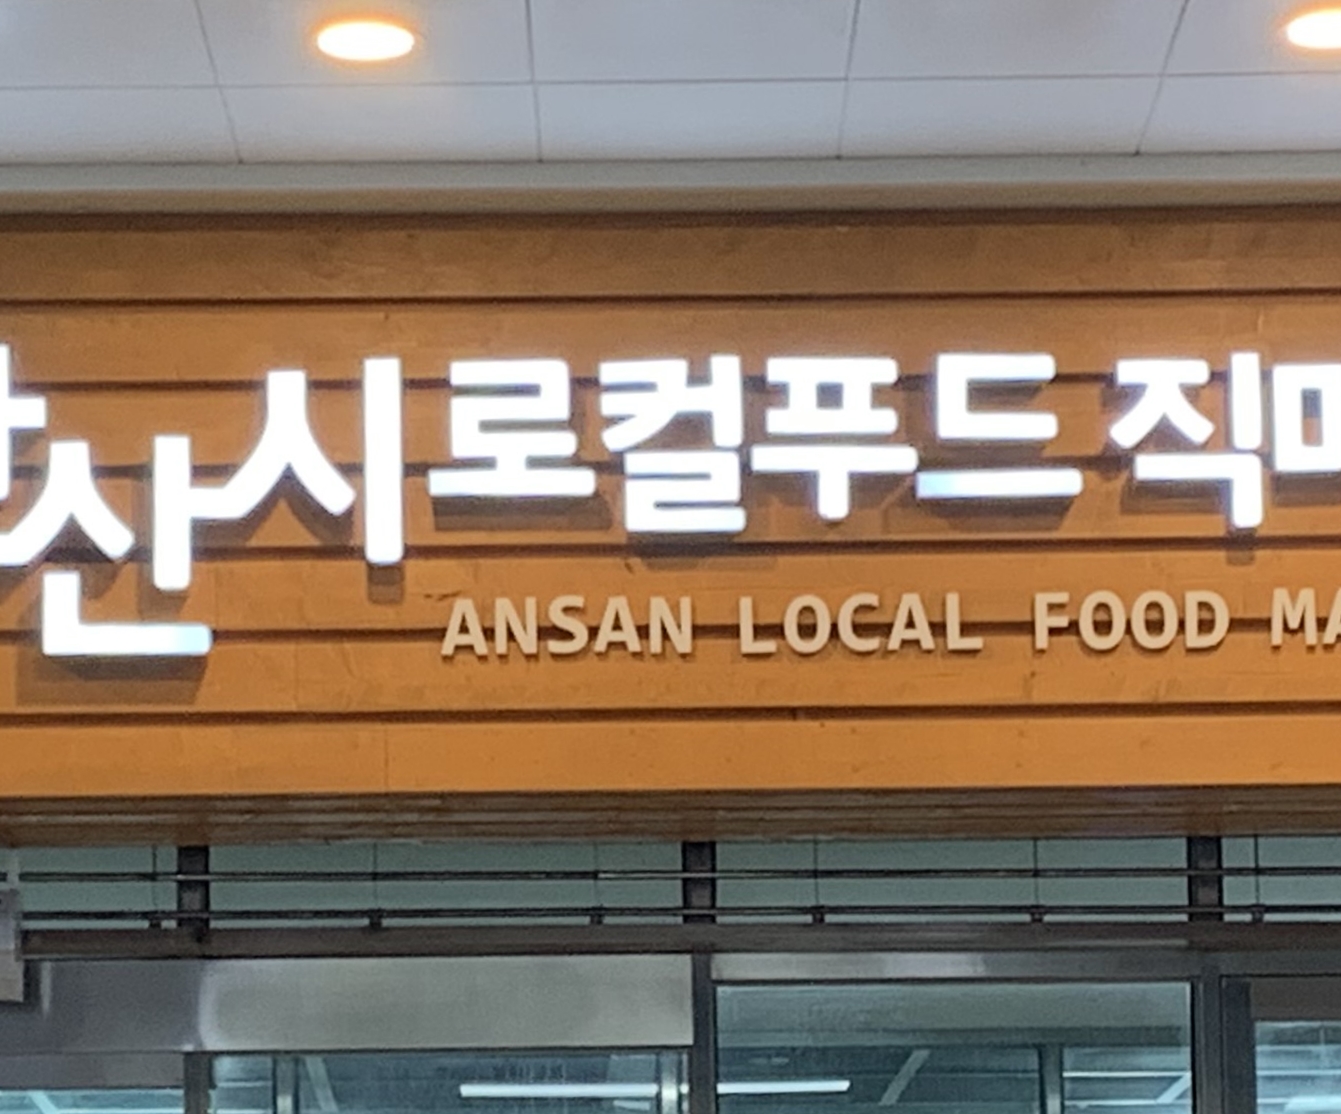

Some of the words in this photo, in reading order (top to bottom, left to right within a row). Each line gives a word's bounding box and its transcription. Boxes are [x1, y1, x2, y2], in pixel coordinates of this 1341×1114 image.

[426, 351, 1083, 535] 로컬푸드
[440, 596, 695, 656] ANSAN
[737, 593, 985, 654] LOCAL
[1032, 590, 1231, 651] FOOD
